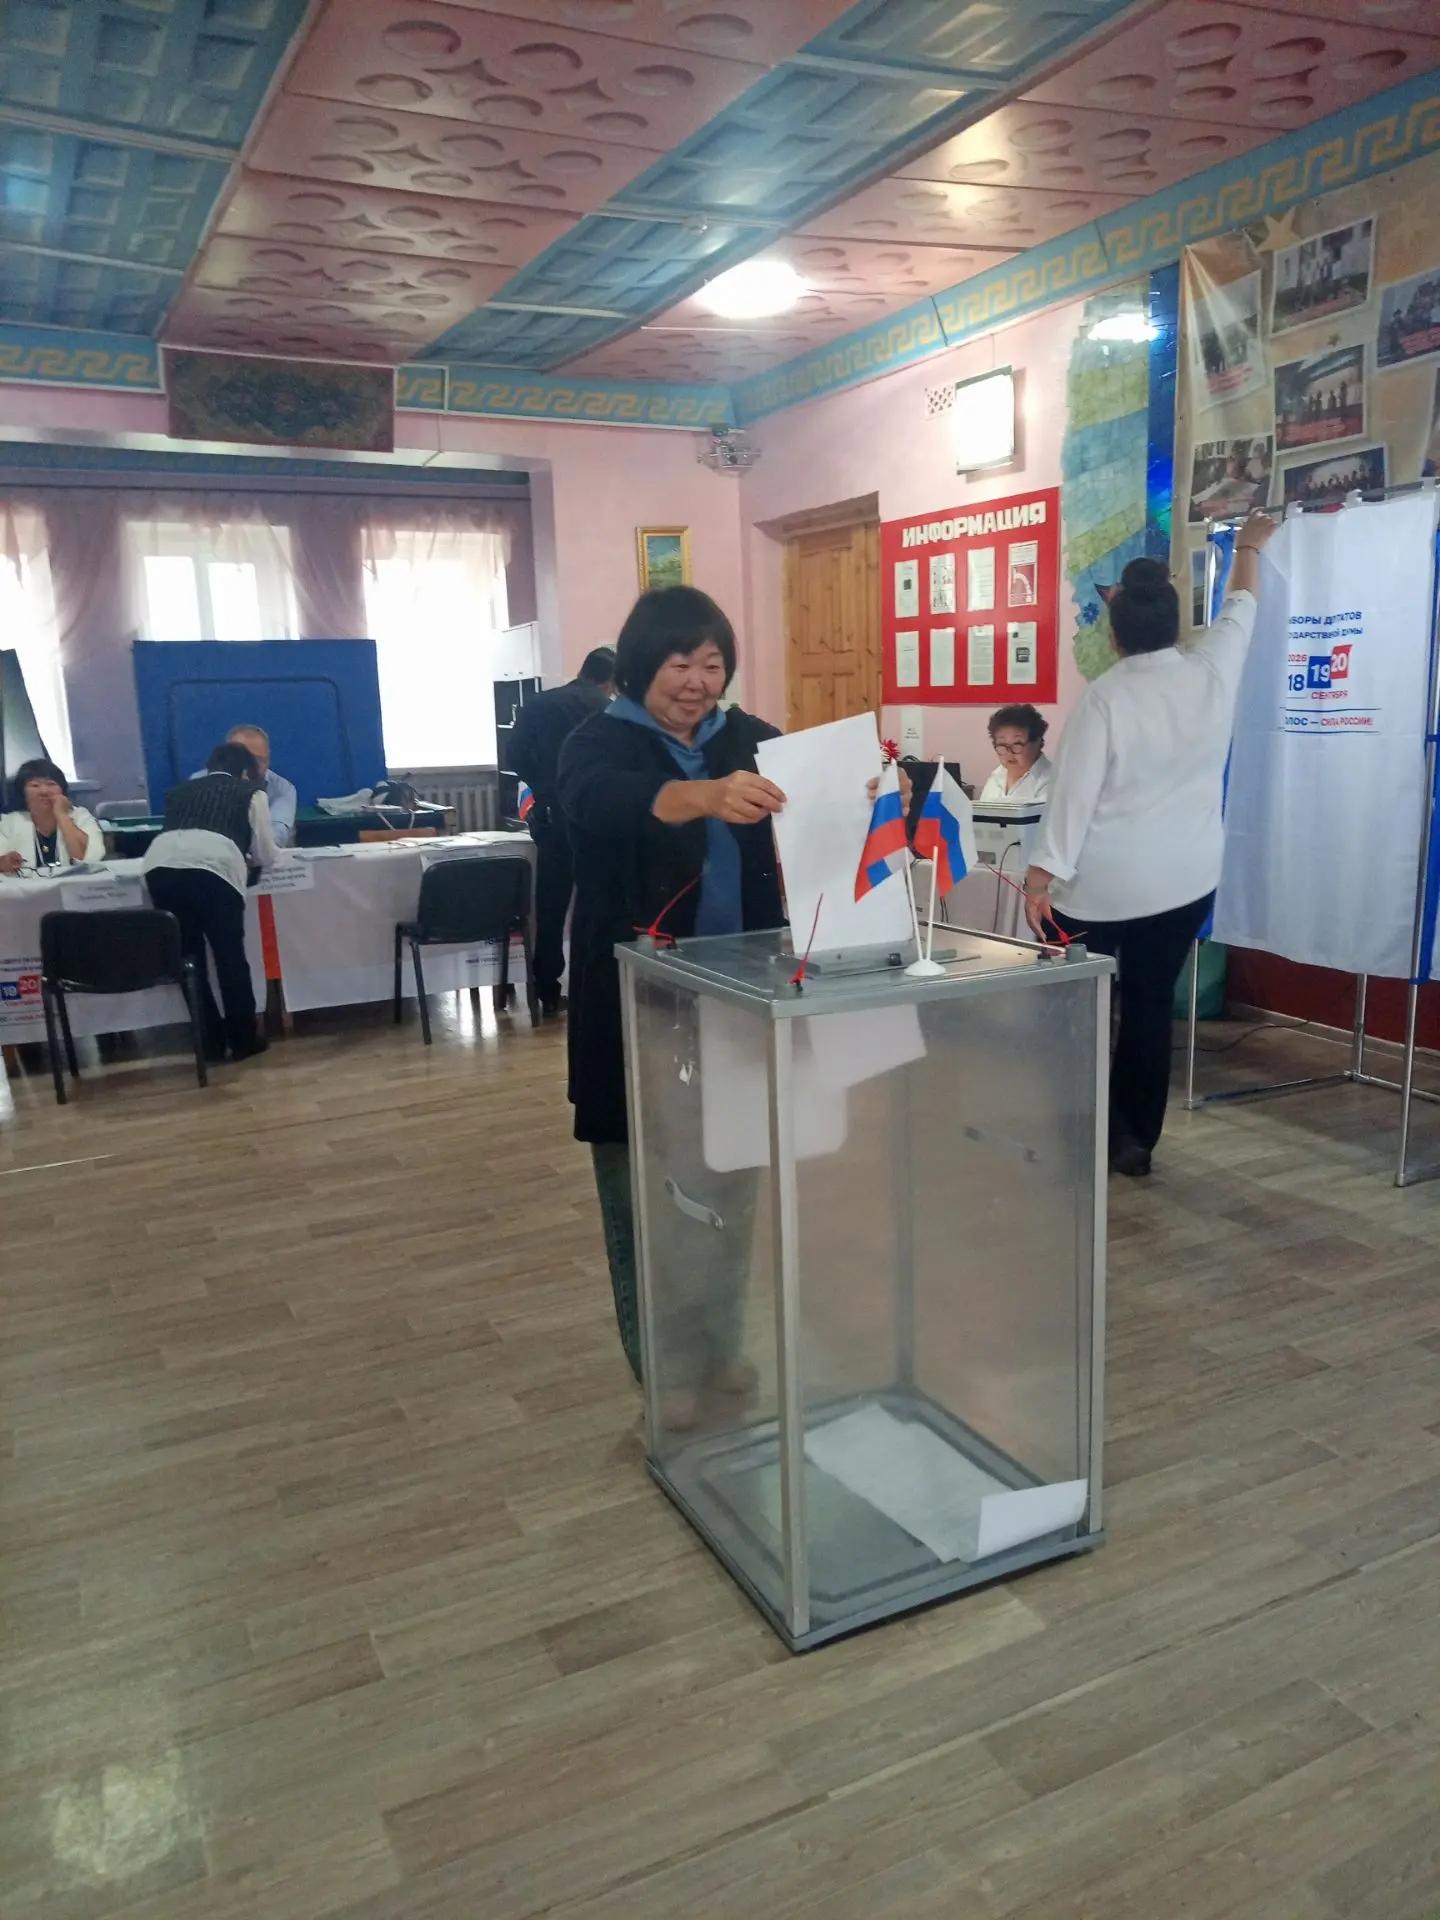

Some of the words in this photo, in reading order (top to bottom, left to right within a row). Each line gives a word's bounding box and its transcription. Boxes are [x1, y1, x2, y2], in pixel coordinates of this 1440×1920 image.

[902, 501, 1046, 548] ИНФОРМАЦИЯ
[1288, 674, 1304, 691] 18
[1311, 664, 1331, 682] 19
[1331, 653, 1347, 672] 20
